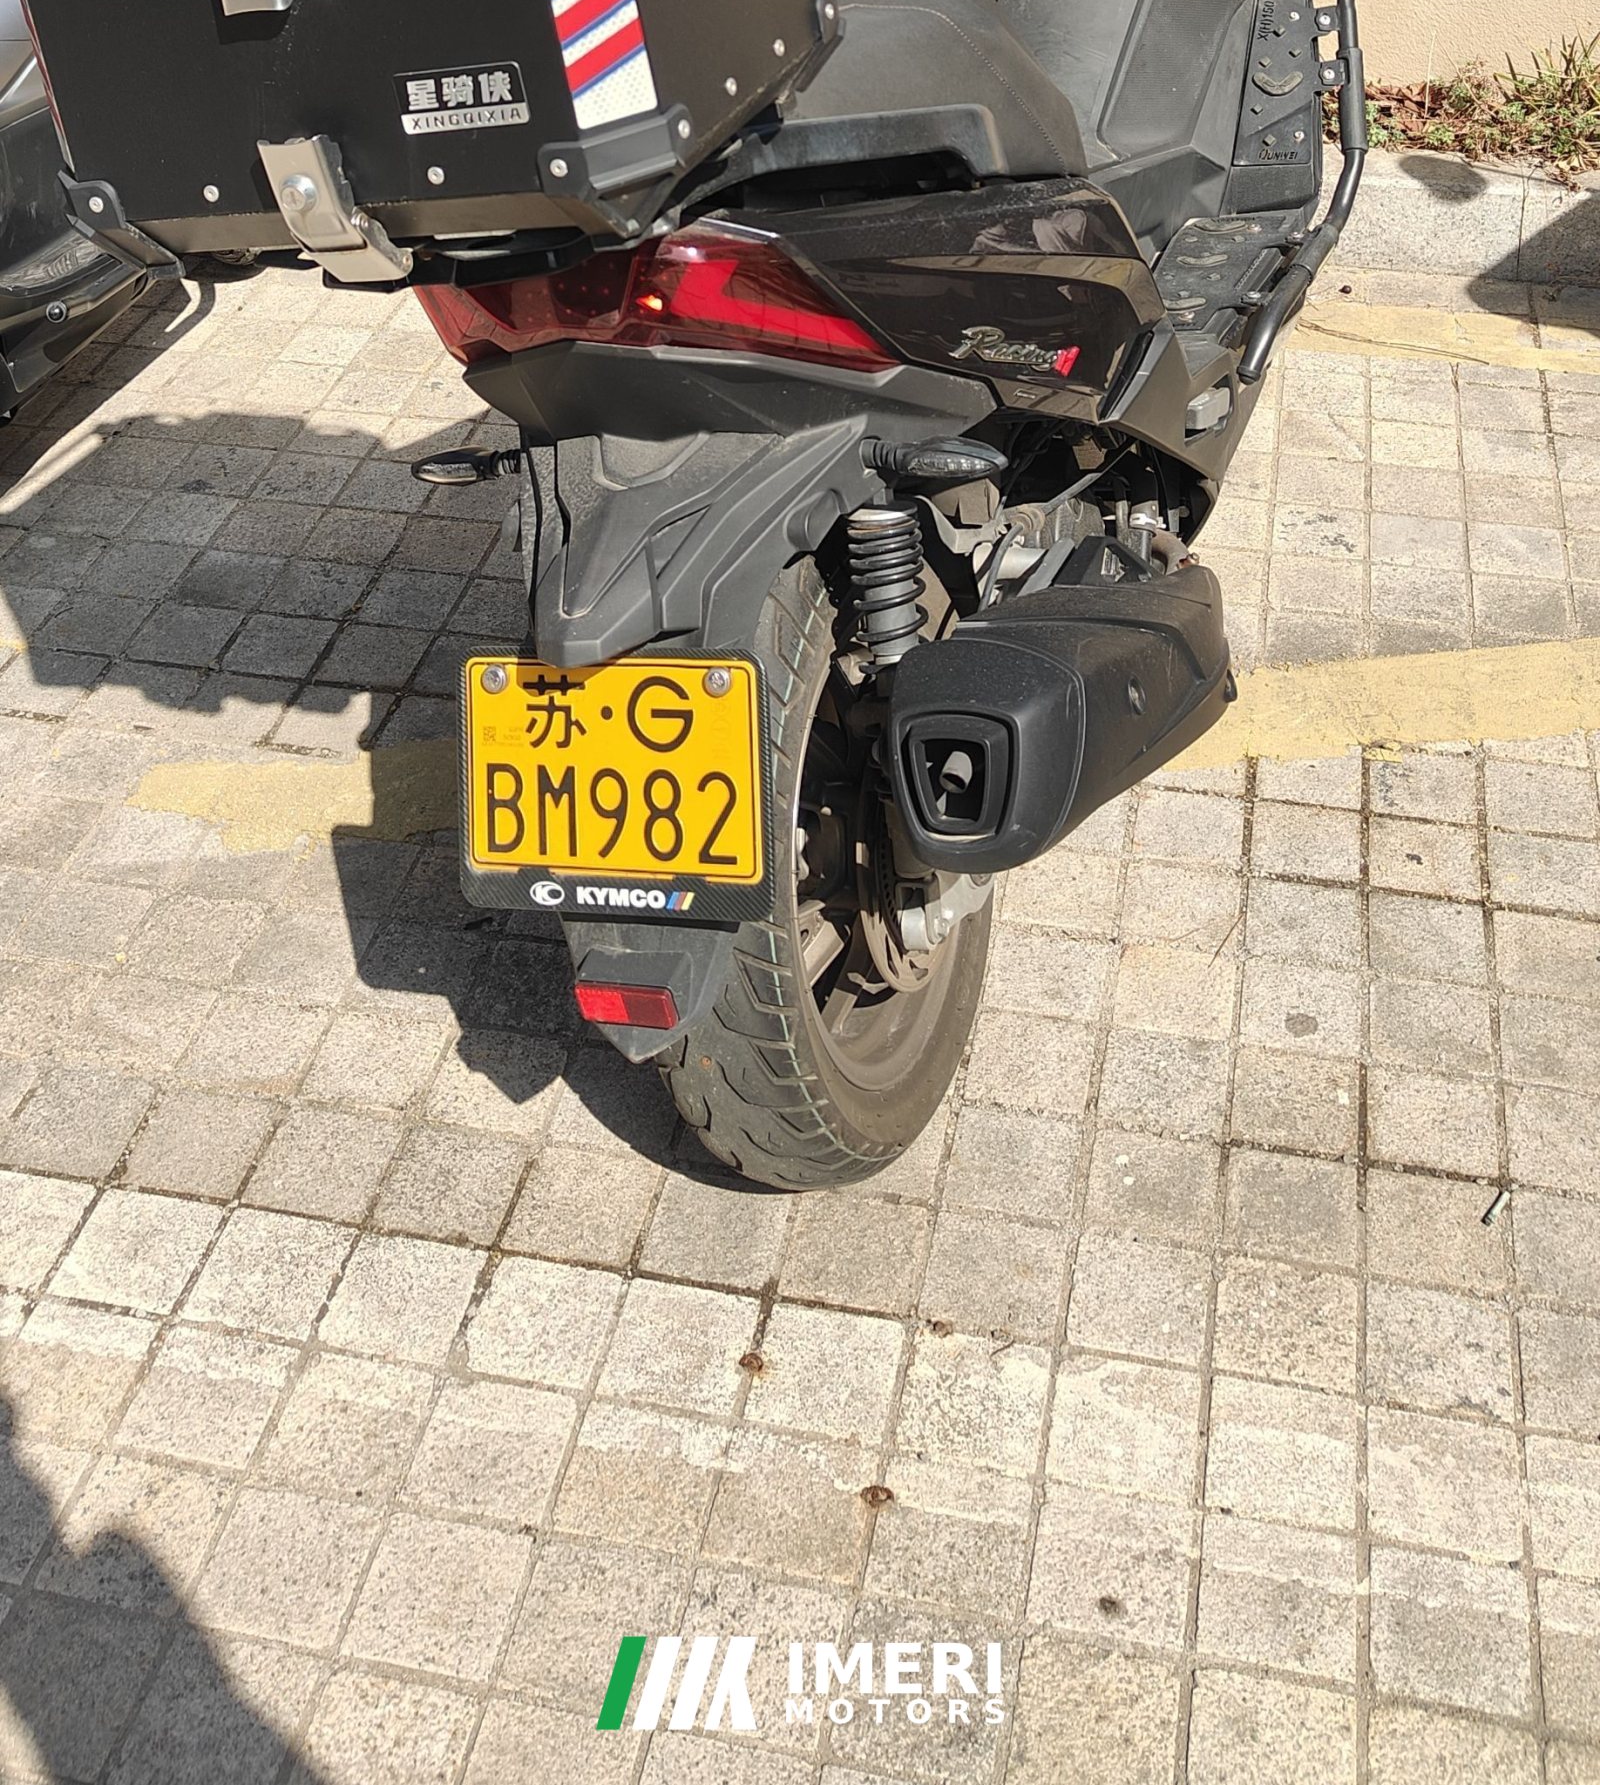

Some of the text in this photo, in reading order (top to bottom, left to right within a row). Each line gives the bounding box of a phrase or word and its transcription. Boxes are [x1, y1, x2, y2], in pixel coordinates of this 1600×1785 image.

[406, 71, 513, 111] 星骑侠
[412, 108, 521, 130] XINGQIXIA
[486, 763, 738, 866] BM982
[576, 885, 666, 910] KYMCO
